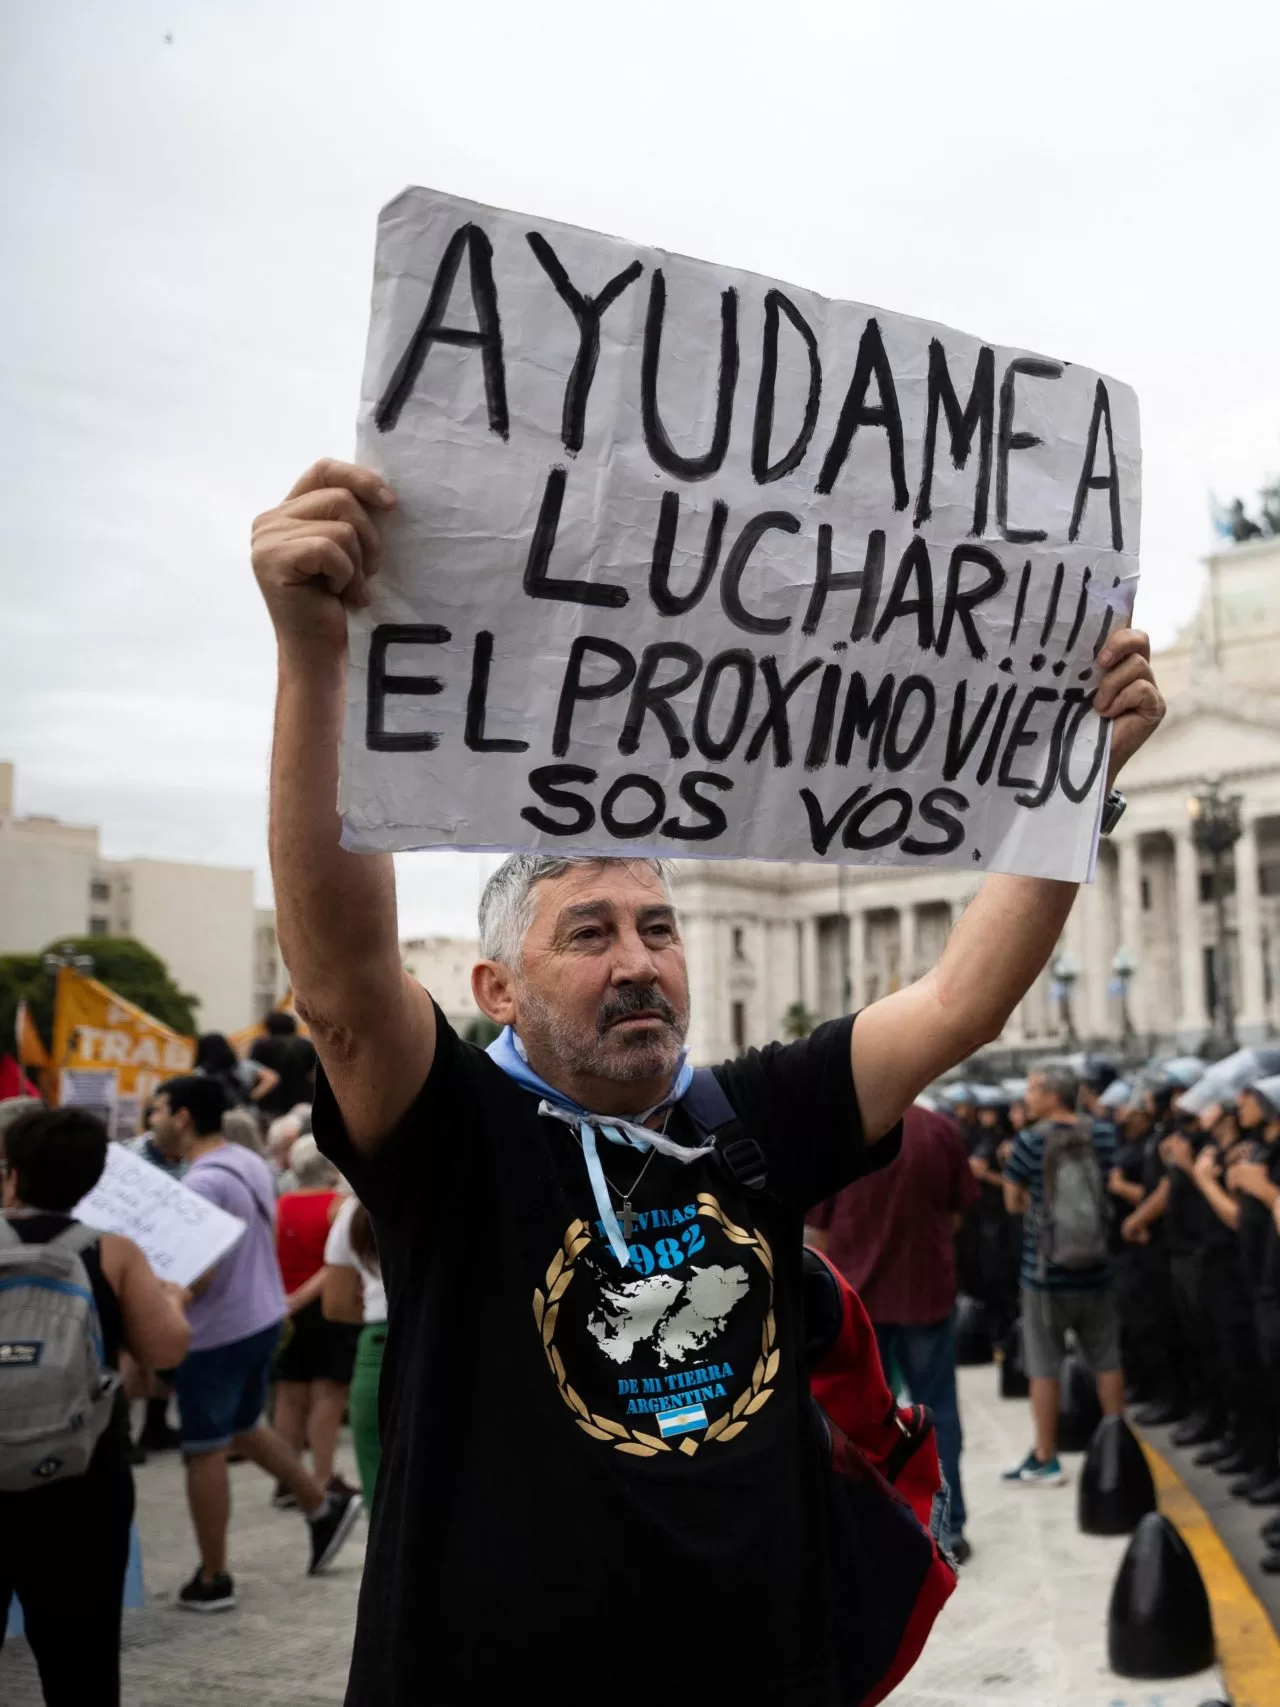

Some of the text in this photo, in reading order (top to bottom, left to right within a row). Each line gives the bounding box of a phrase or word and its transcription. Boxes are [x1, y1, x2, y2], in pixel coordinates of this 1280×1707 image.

[374, 222, 1124, 551] AYUDAME A
[364, 623, 529, 754] EL
[942, 675, 1109, 809] VIEJO
[520, 764, 982, 862] SOS VOS.
[595, 1203, 697, 1238] MVINAS
[617, 1361, 734, 1396] DE MI TIERRA
[625, 1382, 728, 1416] ARGENTINA
